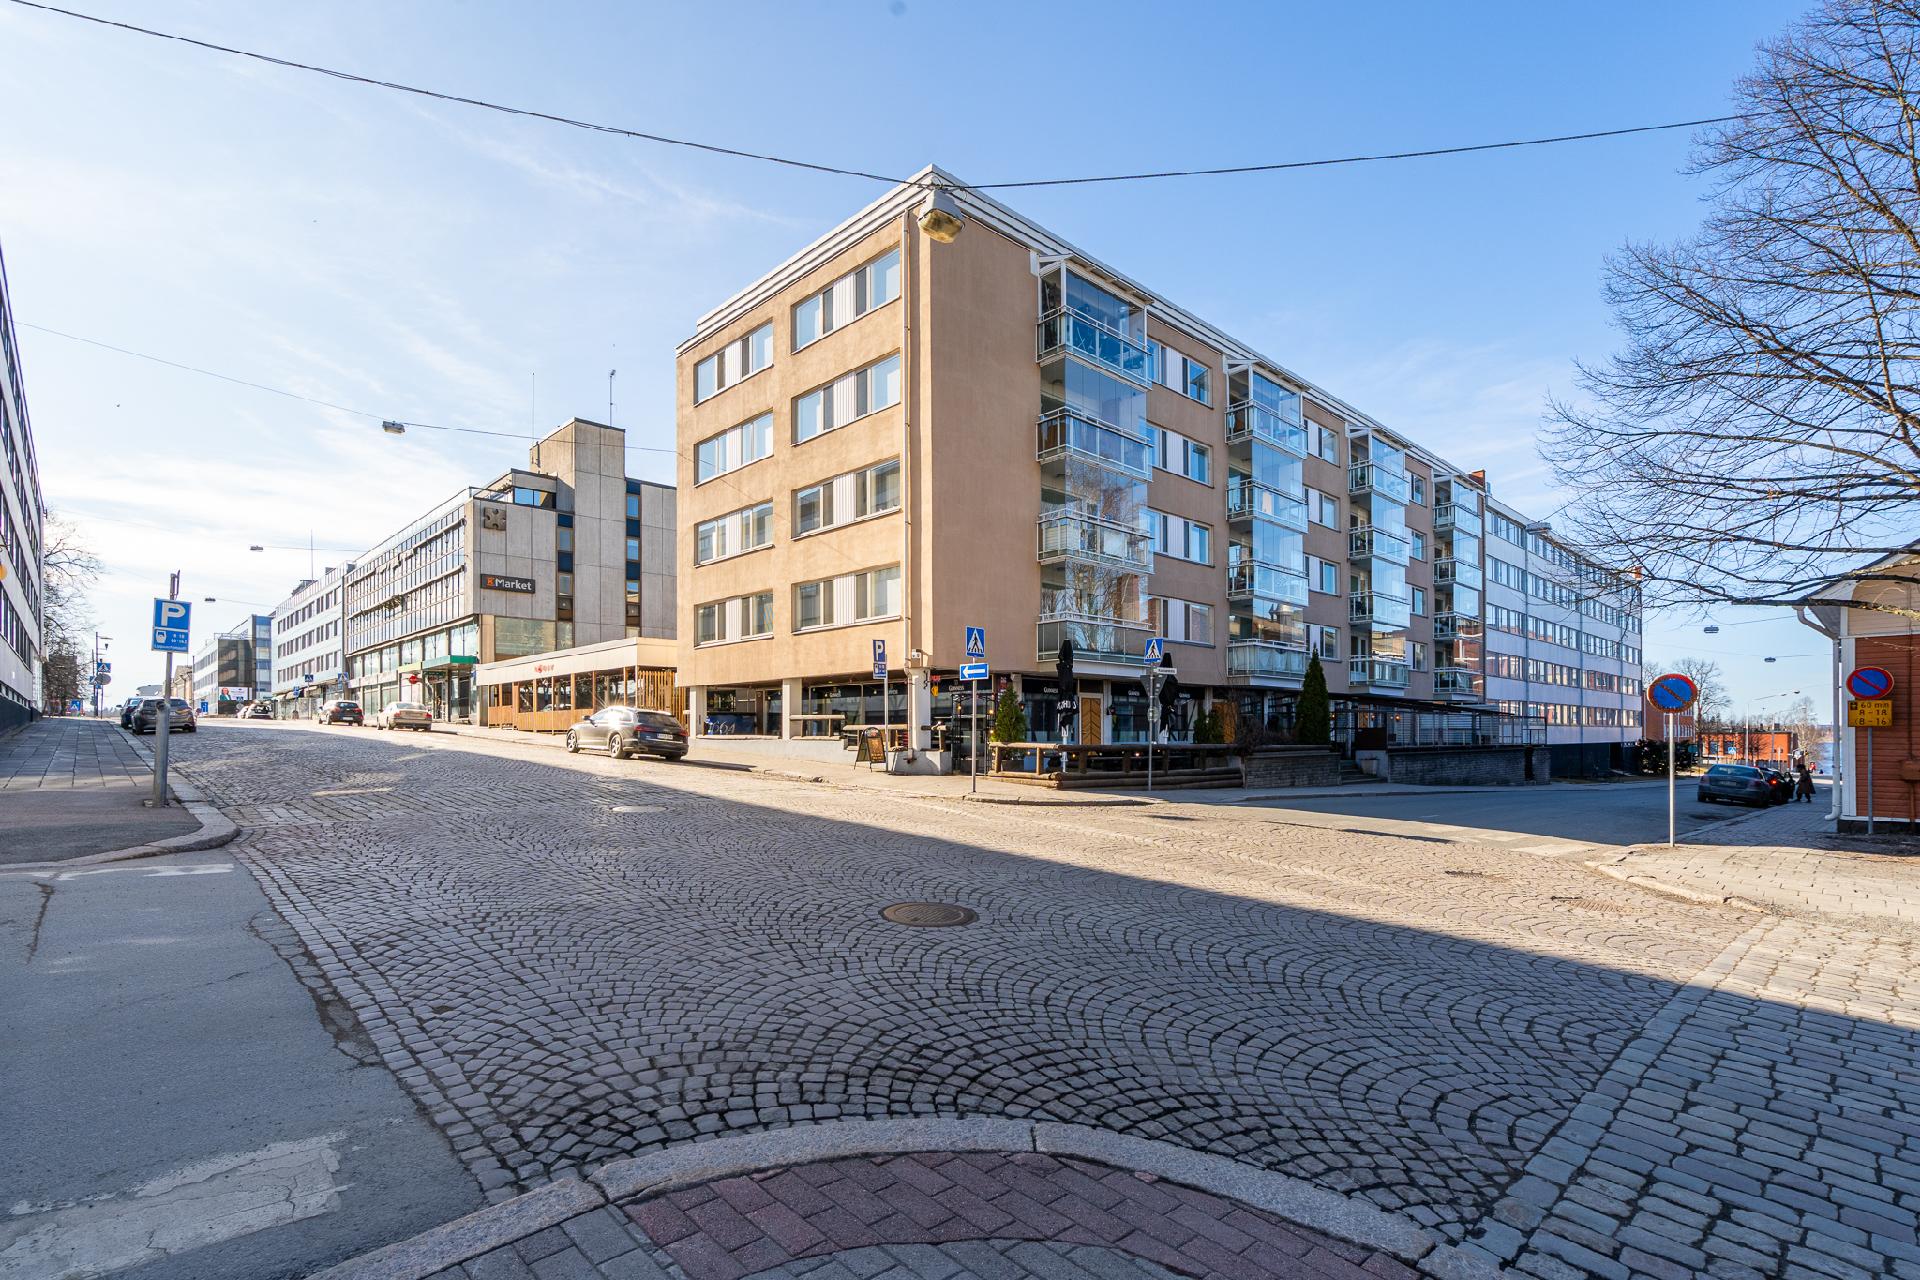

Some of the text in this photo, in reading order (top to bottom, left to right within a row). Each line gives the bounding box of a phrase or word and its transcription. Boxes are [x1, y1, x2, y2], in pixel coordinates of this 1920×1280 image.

[495, 578, 532, 590] Market
[161, 602, 186, 627] P
[875, 640, 884, 661] P
